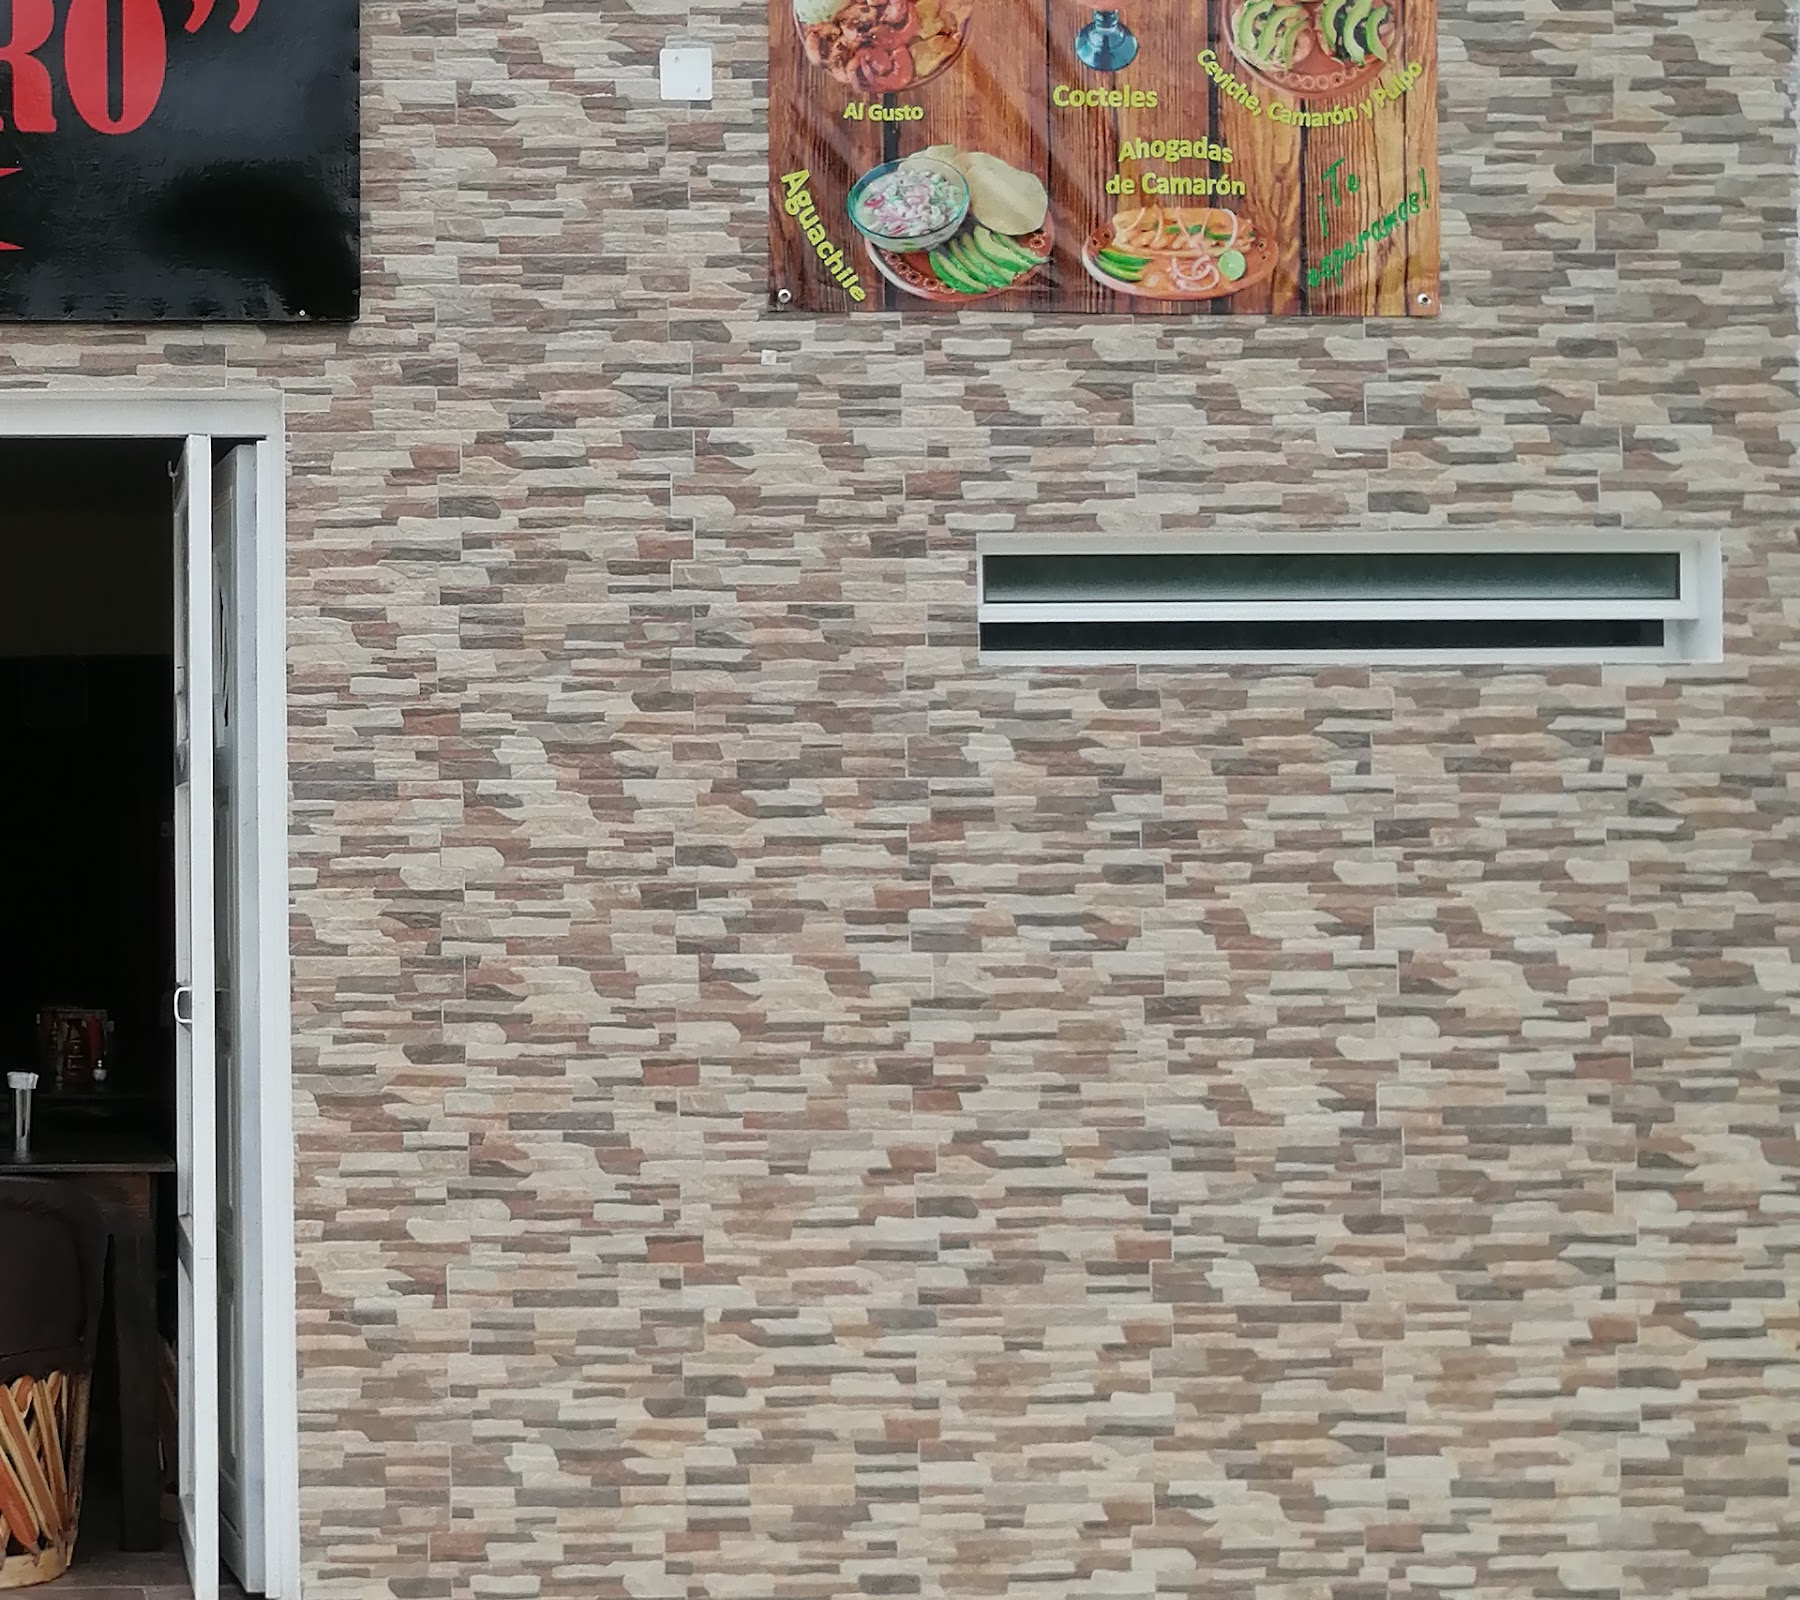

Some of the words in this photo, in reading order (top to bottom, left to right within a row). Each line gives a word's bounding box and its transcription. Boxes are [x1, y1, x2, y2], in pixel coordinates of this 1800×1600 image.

[1052, 84, 1159, 108] Cocteles
[1197, 49, 1263, 117] Ceviche,
[1266, 101, 1358, 129] Camarón
[1358, 99, 1374, 119] y
[1372, 61, 1423, 108] Pulpo
[843, 102, 864, 121] Al
[868, 103, 924, 122] Gusto
[1117, 135, 1234, 164] Ahogadas
[1105, 173, 1135, 195] de
[1141, 172, 1246, 196] Camarón
[780, 168, 867, 303] Aguachile
[1306, 167, 1430, 288] esperamos!
